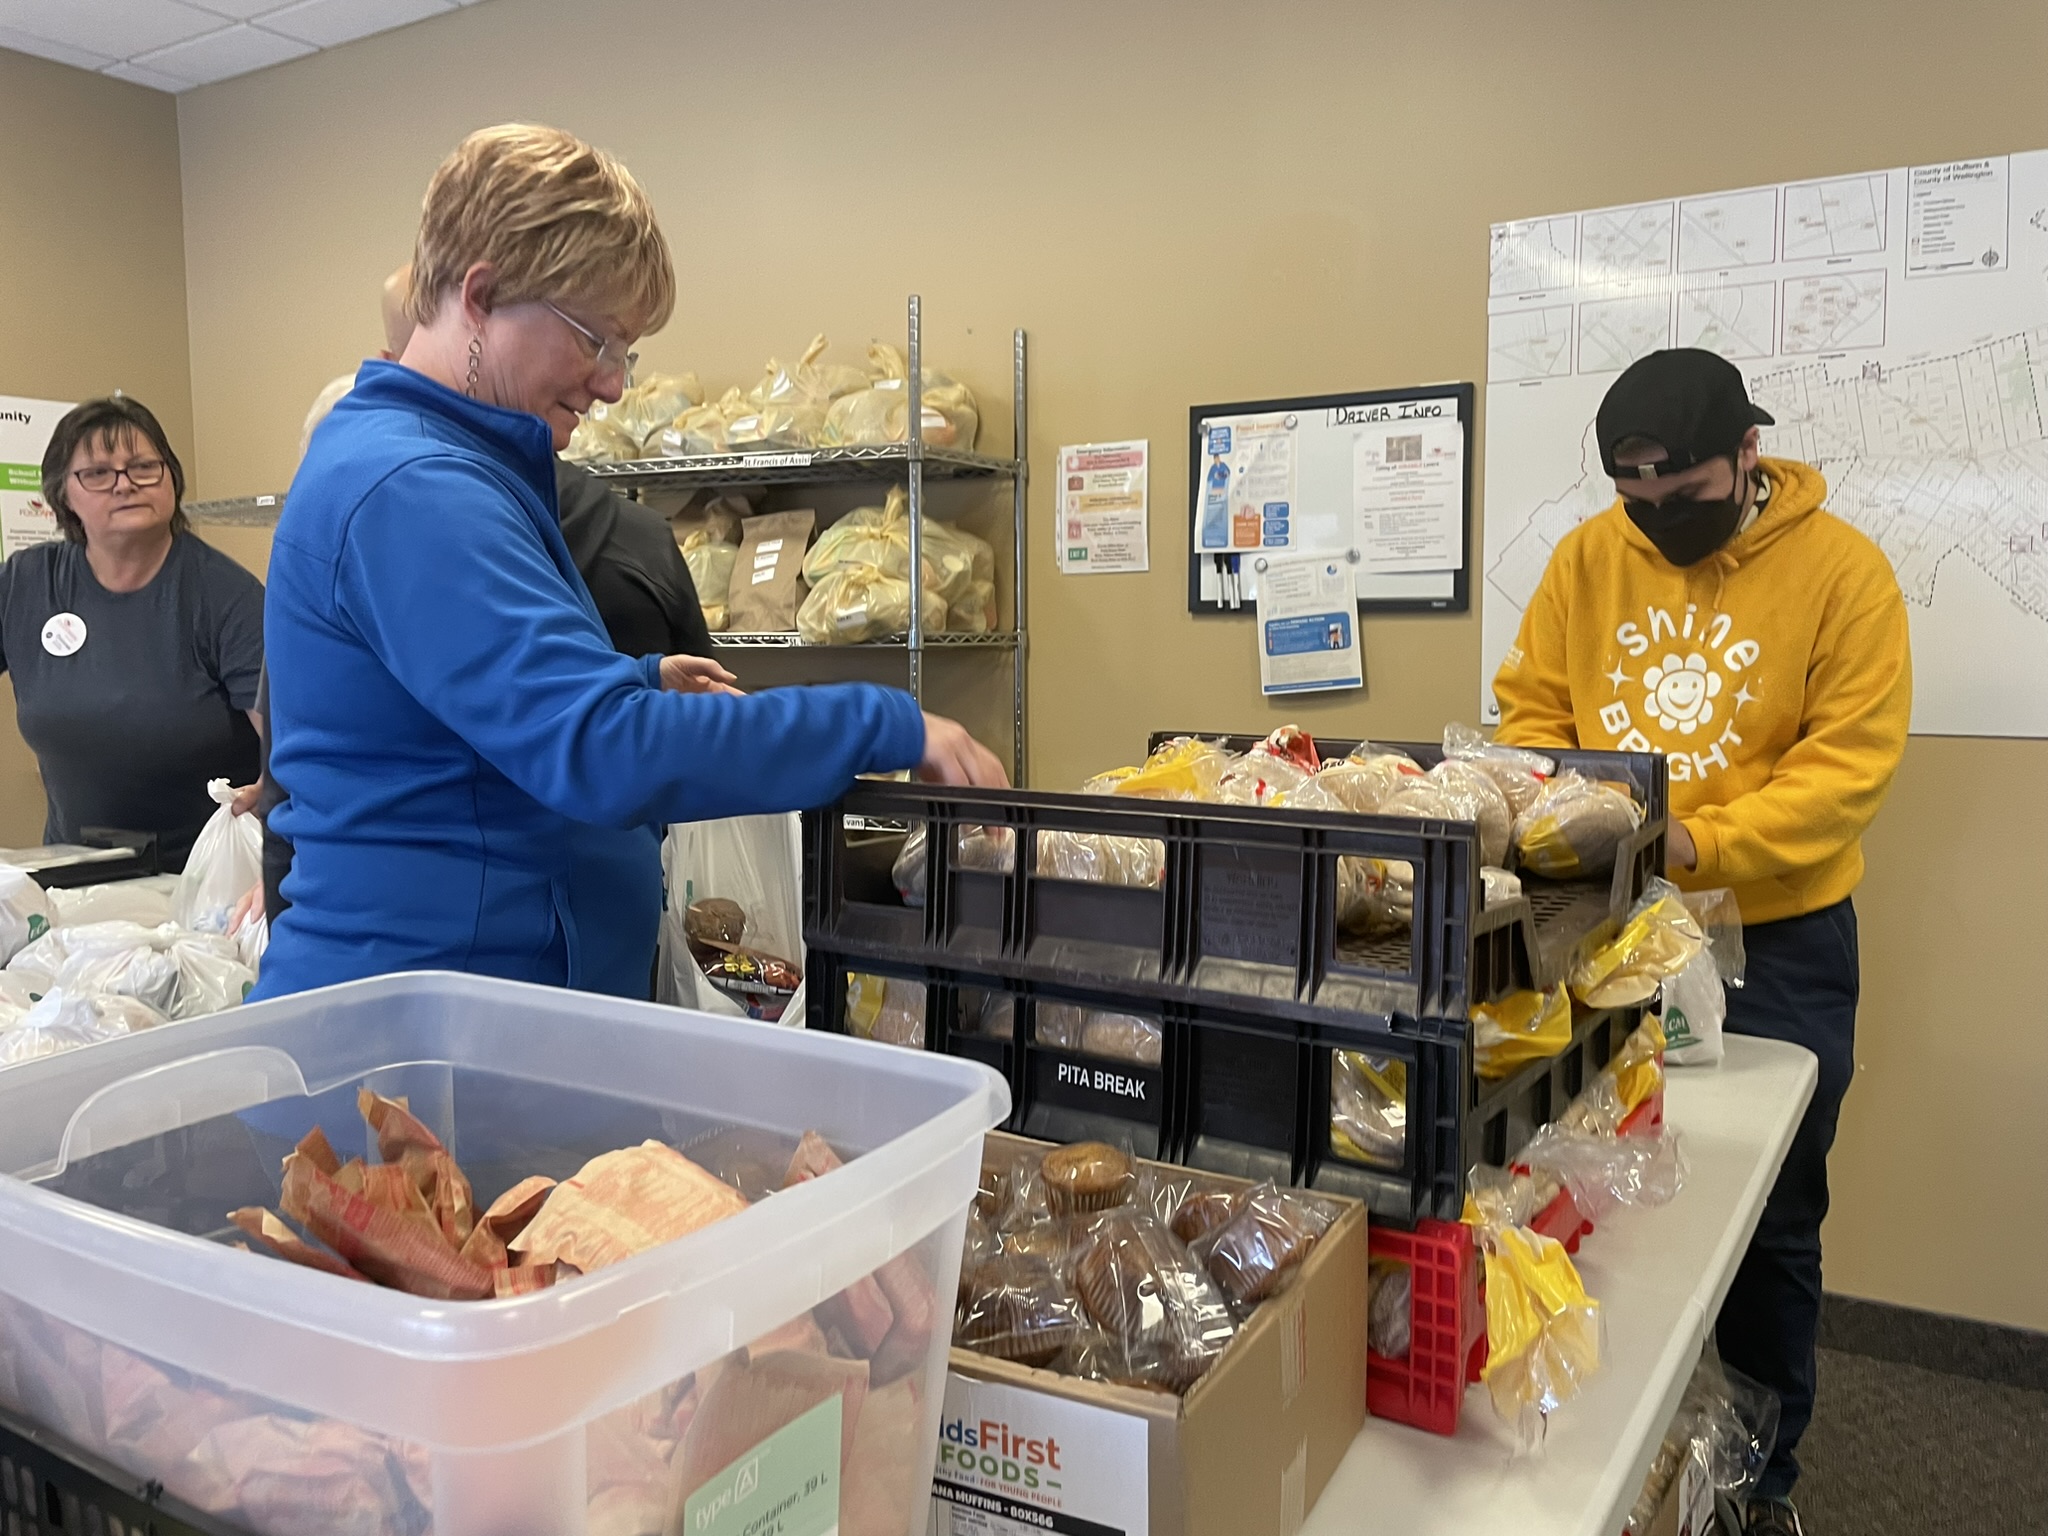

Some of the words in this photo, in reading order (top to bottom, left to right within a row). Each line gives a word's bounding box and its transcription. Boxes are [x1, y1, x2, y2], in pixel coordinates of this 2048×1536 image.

[1335, 406, 1391, 425] DRIVER
[1398, 402, 1442, 419] INFO
[780, 456, 788, 465] of
[789, 454, 811, 465] Assisi
[1616, 603, 1760, 672] shine
[1599, 700, 1742, 782] BRGHT
[846, 819, 864, 827] vans
[1058, 1062, 1090, 1088] PITA
[1094, 1070, 1145, 1101] BREAK
[940, 1443, 1040, 1490] FOODS
[696, 1487, 731, 1531] type
[955, 1490, 1002, 1513] MUFFINS
[981, 1477, 997, 1489] FOR
[1000, 1481, 1029, 1498] YOUNG
[1031, 1489, 1062, 1508] PEOPLE
